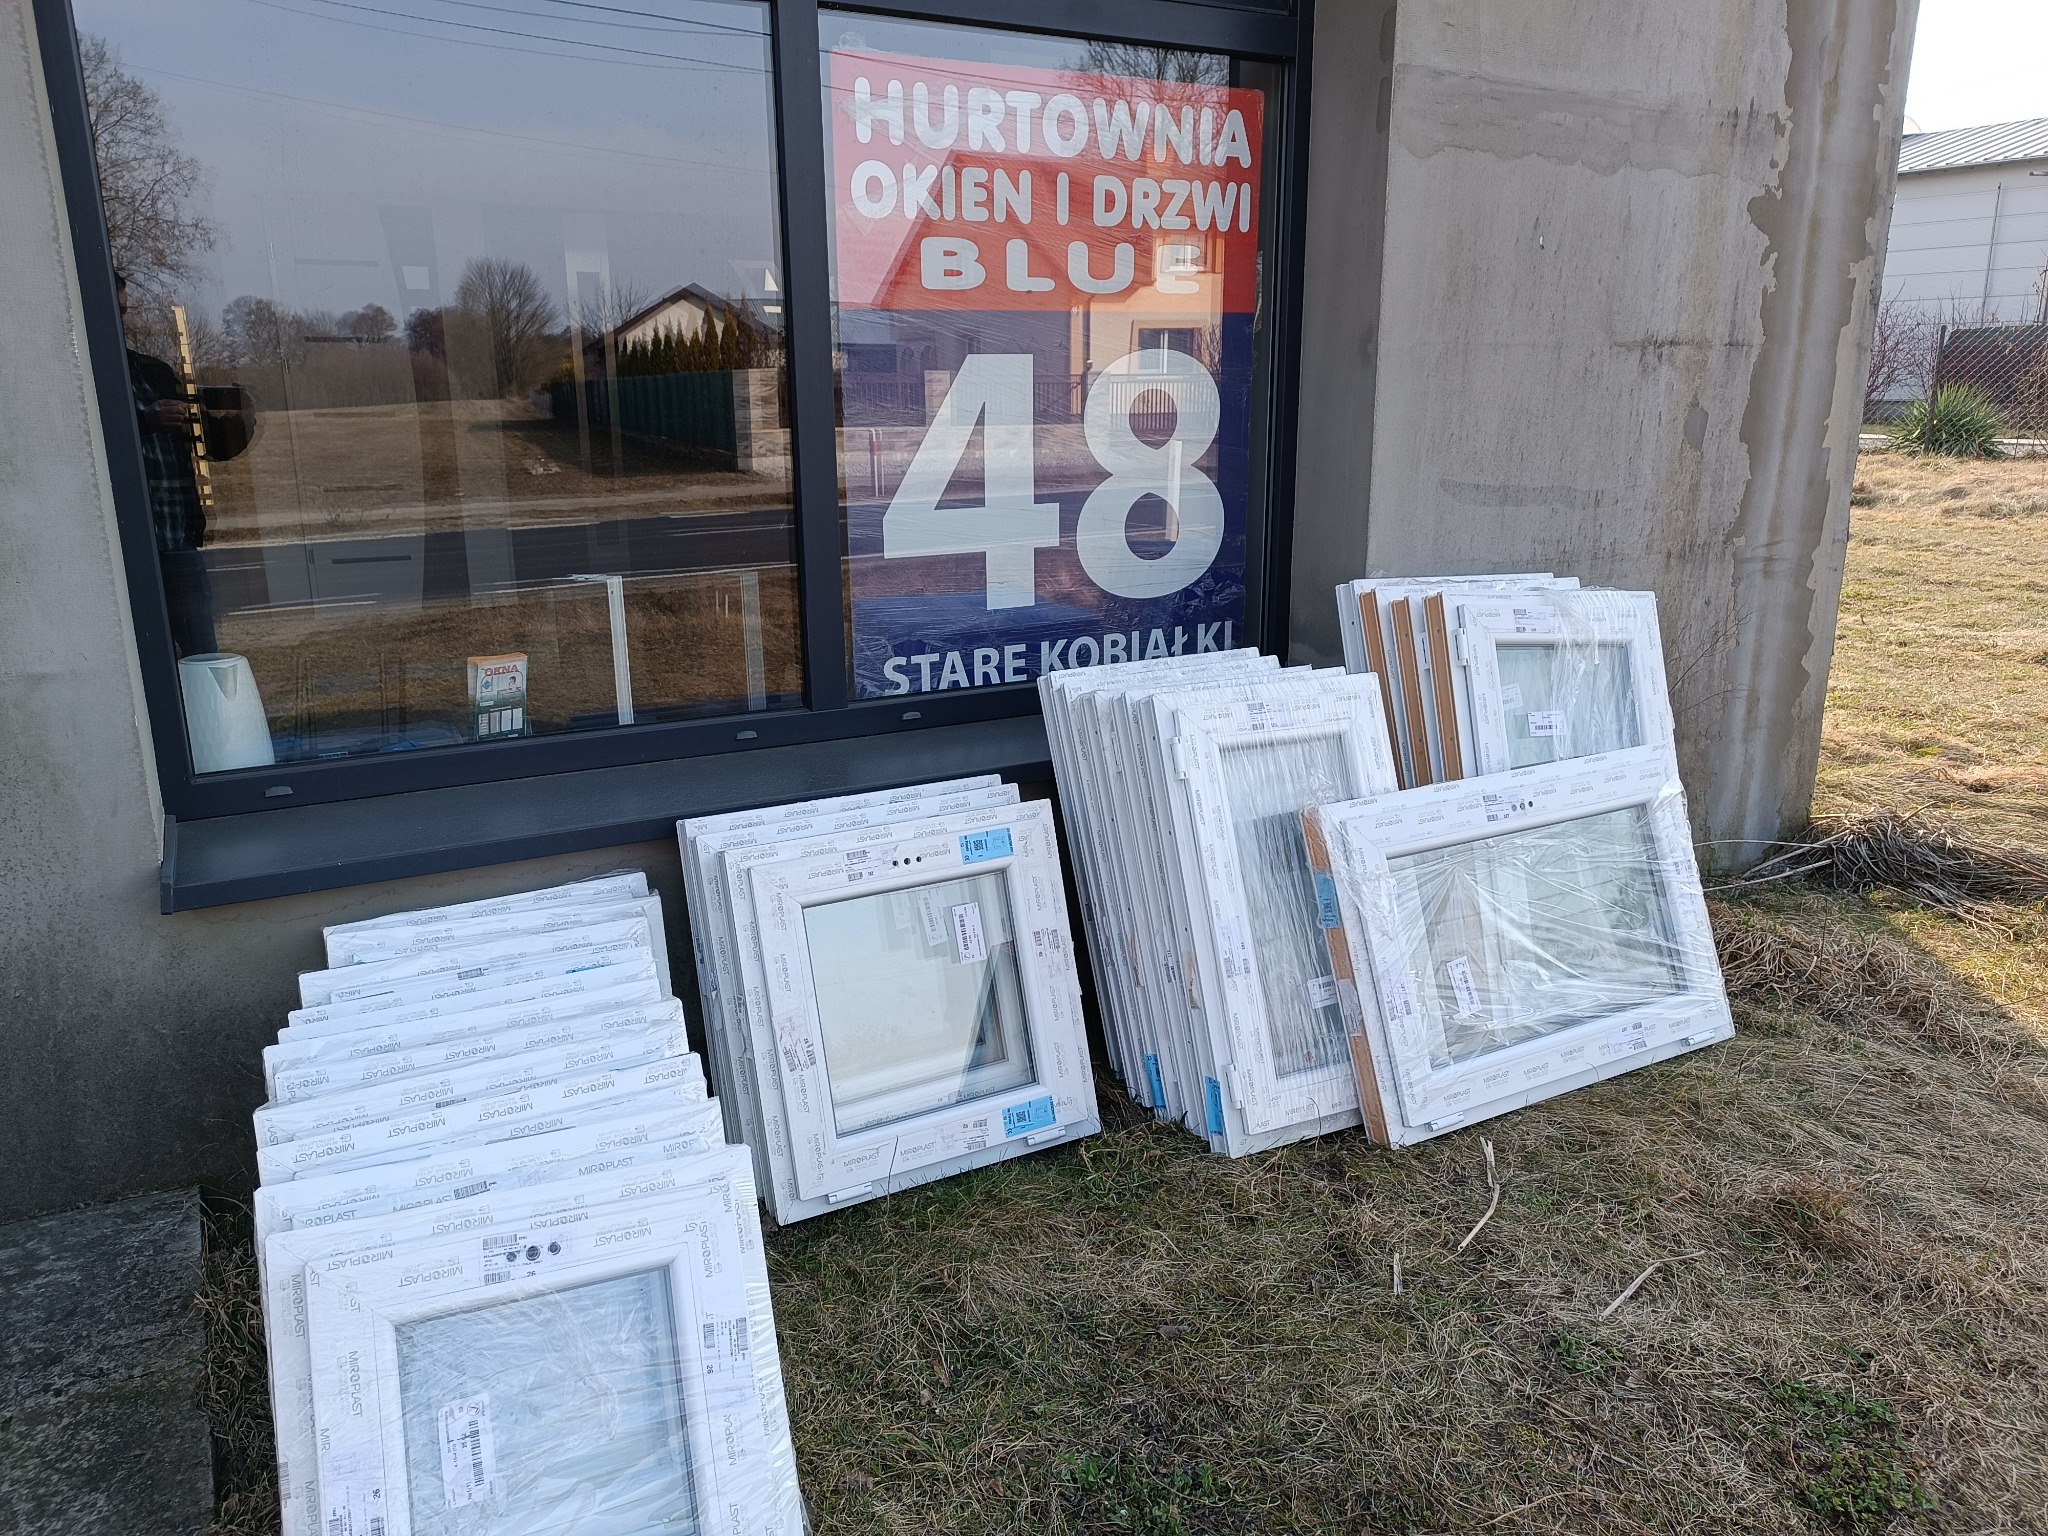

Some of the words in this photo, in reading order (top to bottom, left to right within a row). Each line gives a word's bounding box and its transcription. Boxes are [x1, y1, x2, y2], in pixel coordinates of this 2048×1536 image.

[854, 76, 1251, 169] HURTOWNIA
[850, 159, 1032, 225] OKIEN
[1056, 171, 1069, 226] I
[1093, 175, 1251, 233] DRZWI
[920, 236, 1201, 294] BLUE
[883, 348, 1225, 610] 48
[883, 643, 1028, 695] STARE
[1040, 621, 1233, 677] KOBIAŁKI
[484, 664, 520, 676] OKNA
[1349, 798, 1378, 808] MIROPLAST
[833, 818, 869, 830] MIROPLAST
[963, 813, 998, 825] MIROPLAST
[1375, 818, 1403, 829] MIROPLAST
[1417, 814, 1445, 825] MIROPLAST
[856, 831, 893, 843] MIROPLAST
[912, 827, 948, 838] MIROPLAST
[738, 850, 779, 863] MIROPLAST
[807, 867, 845, 879] MIROPLAST
[1032, 875, 1042, 911] MIROPLAST
[776, 892, 787, 932] MIROPLAST
[748, 920, 760, 962] MIROPLAST
[718, 936, 730, 976] MIROPLAST
[780, 953, 792, 993] MIROPLAST
[753, 986, 765, 1028] MIROPLAST
[1049, 985, 1060, 1022] MIROPLAST
[601, 1016, 647, 1030] MIROPLAST
[1233, 1012, 1243, 1050] MIROPLAST
[1668, 1017, 1691, 1030] MIROPLAST
[523, 1033, 574, 1049] MIROPLAST
[443, 1044, 496, 1061] MIROPLAST
[563, 1051, 614, 1069] MIROPLAST
[1054, 1041, 1064, 1078] MIROPLAST
[1560, 1046, 1586, 1059] MIROPLAST
[766, 1048, 780, 1091] MIROPLAST
[1077, 1046, 1088, 1083] MIROPLAST
[1523, 1062, 1549, 1076] MIROPLAST
[737, 1056, 750, 1096] MIROPLAST
[1483, 1070, 1510, 1084] MIROPLAST
[399, 1086, 454, 1106] MIROPLAST
[561, 1079, 615, 1098] MIROPLAST
[798, 1074, 811, 1114] MIROPLAST
[1246, 1068, 1258, 1106] MIROPLAST
[1443, 1088, 1472, 1102] MIROPLAST
[477, 1102, 533, 1122] MIROPLAST
[386, 1117, 446, 1139] MIROPLAST
[509, 1117, 563, 1137] MIROPLAST
[772, 1115, 784, 1158] MIROPLAST
[292, 1142, 355, 1164] MIROPLAST
[843, 1151, 880, 1167] MIROPLAST
[900, 1141, 936, 1157] MIROPLAST
[578, 1156, 634, 1176] MIROPLAST
[415, 1167, 474, 1187] MIROPLAST
[618, 1178, 676, 1198] MIROPLAST
[431, 1214, 494, 1235] MIROPLAST
[530, 1211, 589, 1230] MIROPLAST
[593, 1226, 652, 1247] MIROPLAST
[701, 1221, 713, 1278] MIROPLAST
[325, 1249, 393, 1272] MIROPLAST
[397, 1266, 463, 1288] MIROPLAST
[291, 1274, 306, 1339] MIROPLAST
[706, 1364, 714, 1374] 26
[348, 1350, 363, 1417] MIROPLAST
[372, 1488, 381, 1500] 26
